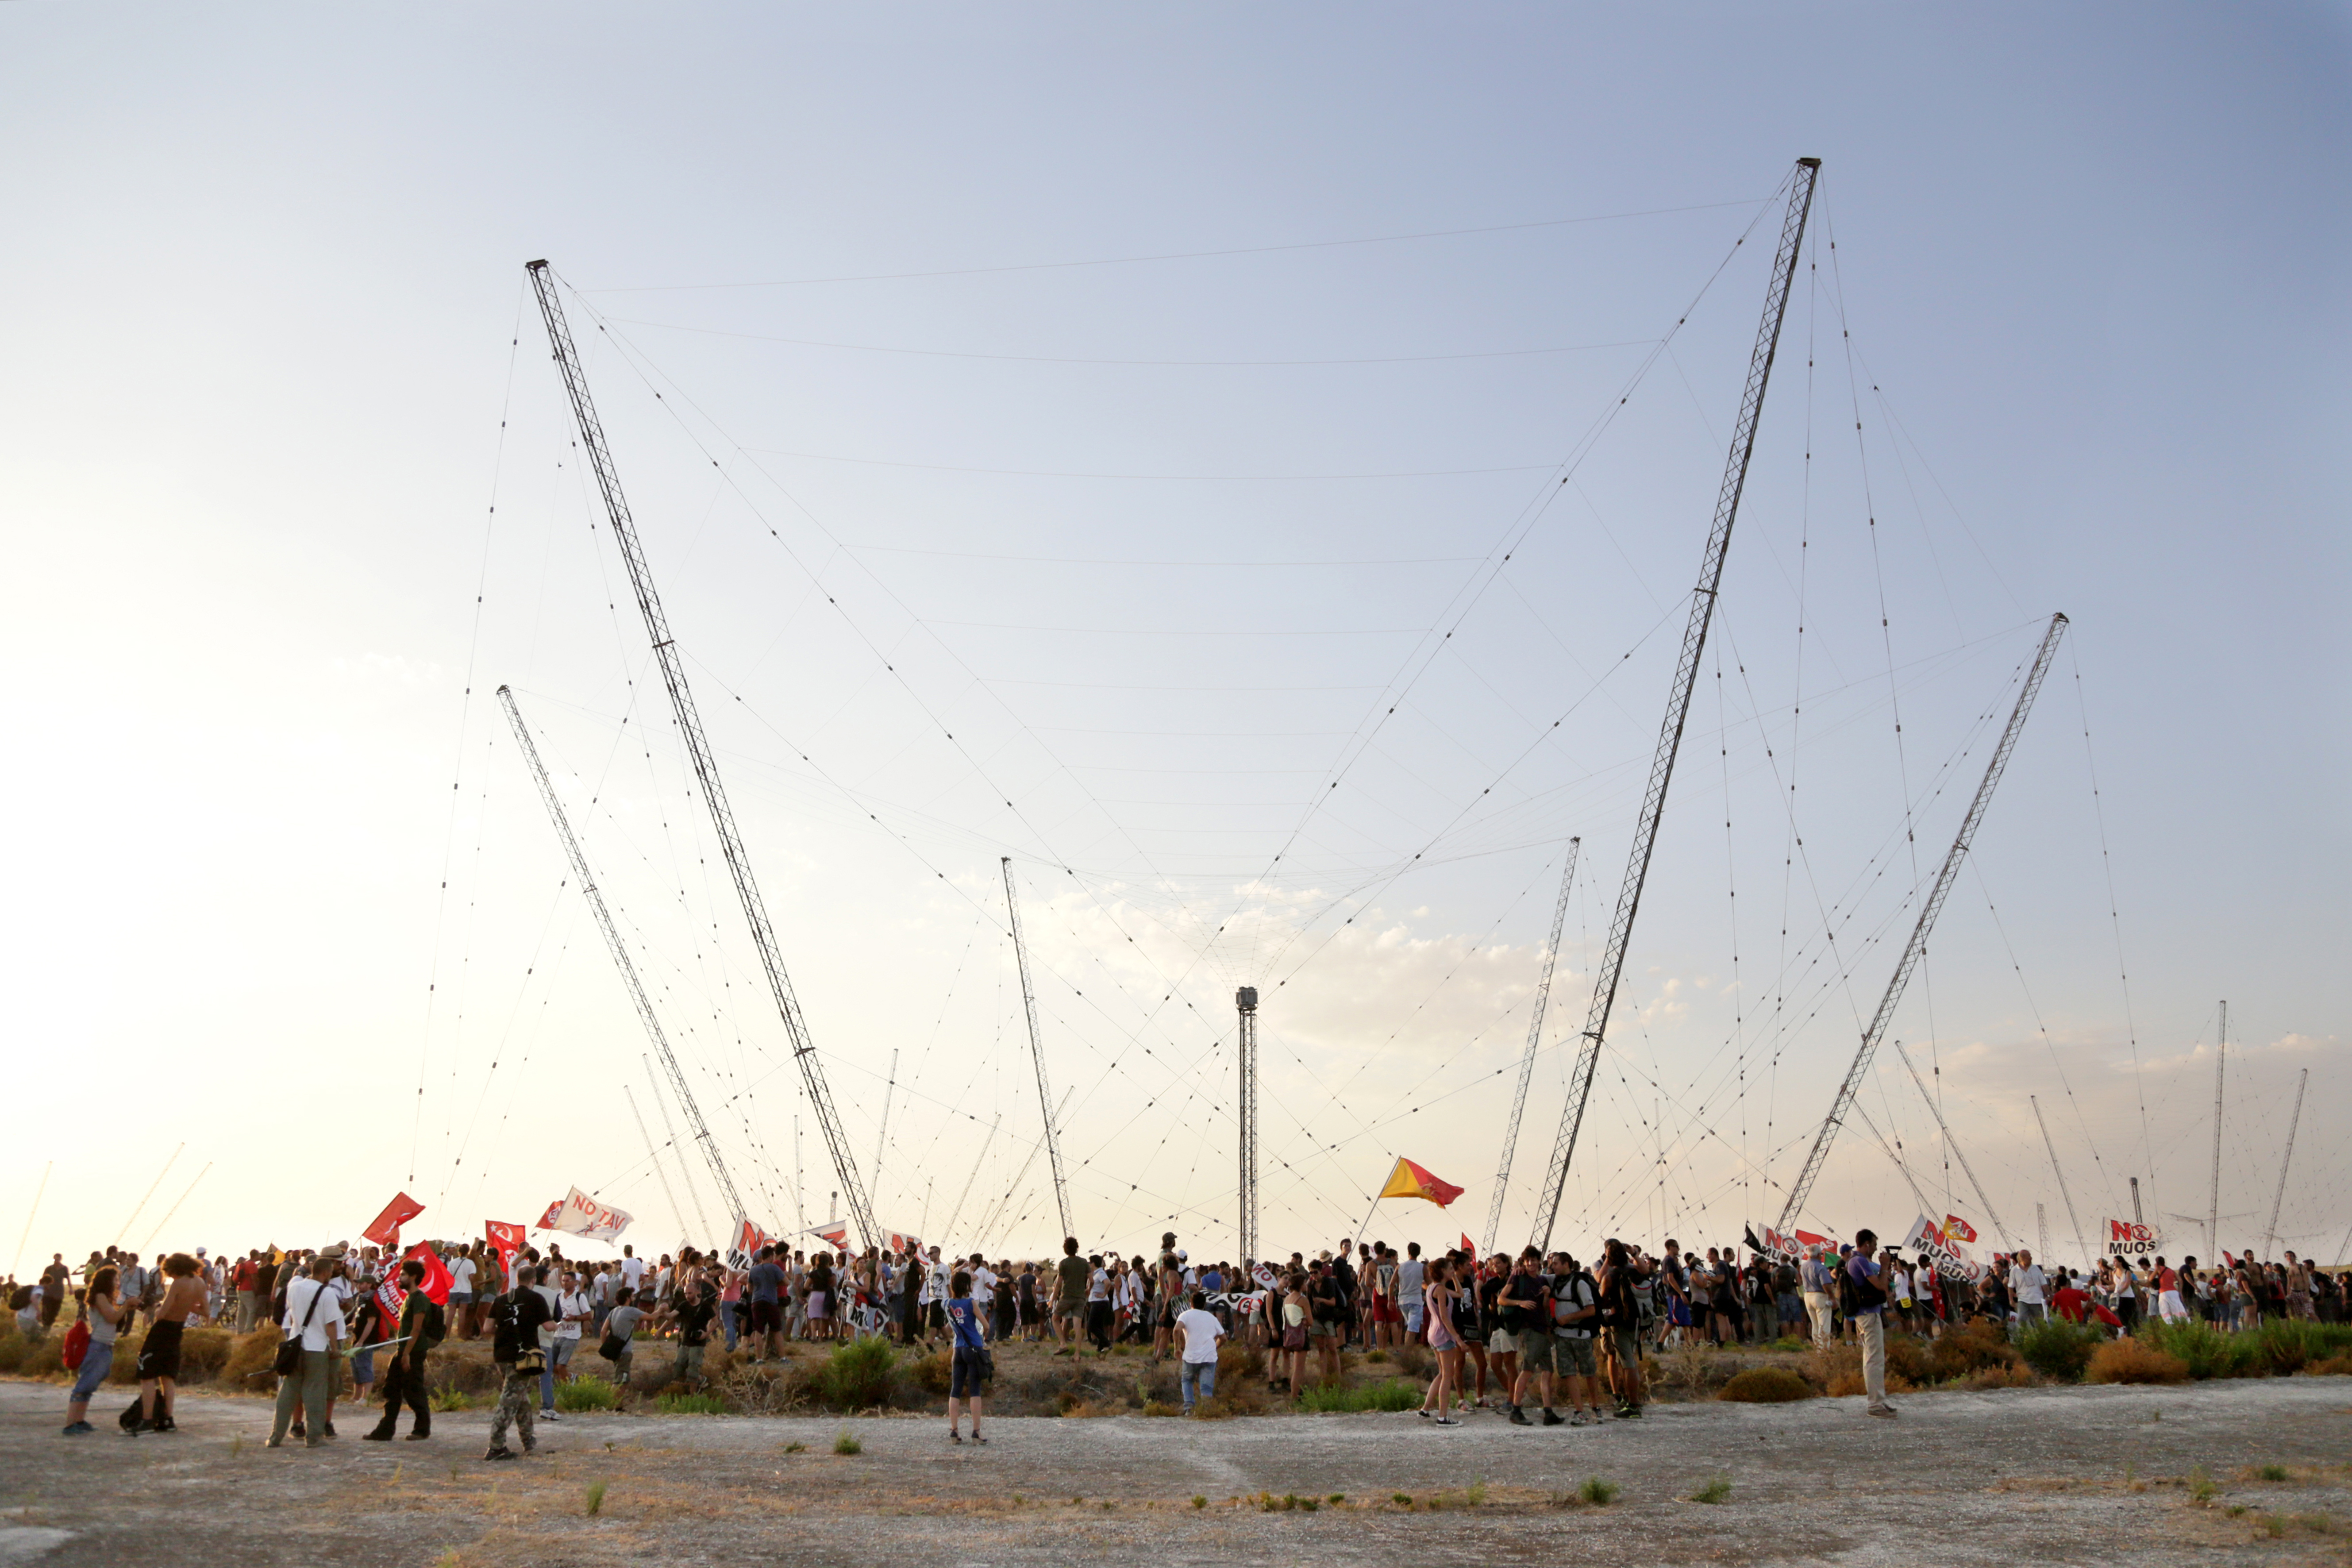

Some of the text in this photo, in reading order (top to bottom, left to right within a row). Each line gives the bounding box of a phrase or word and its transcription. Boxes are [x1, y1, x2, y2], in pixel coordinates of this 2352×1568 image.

[572, 1195, 626, 1230] NO TAV
[2109, 1241, 2156, 1254] MUOS
